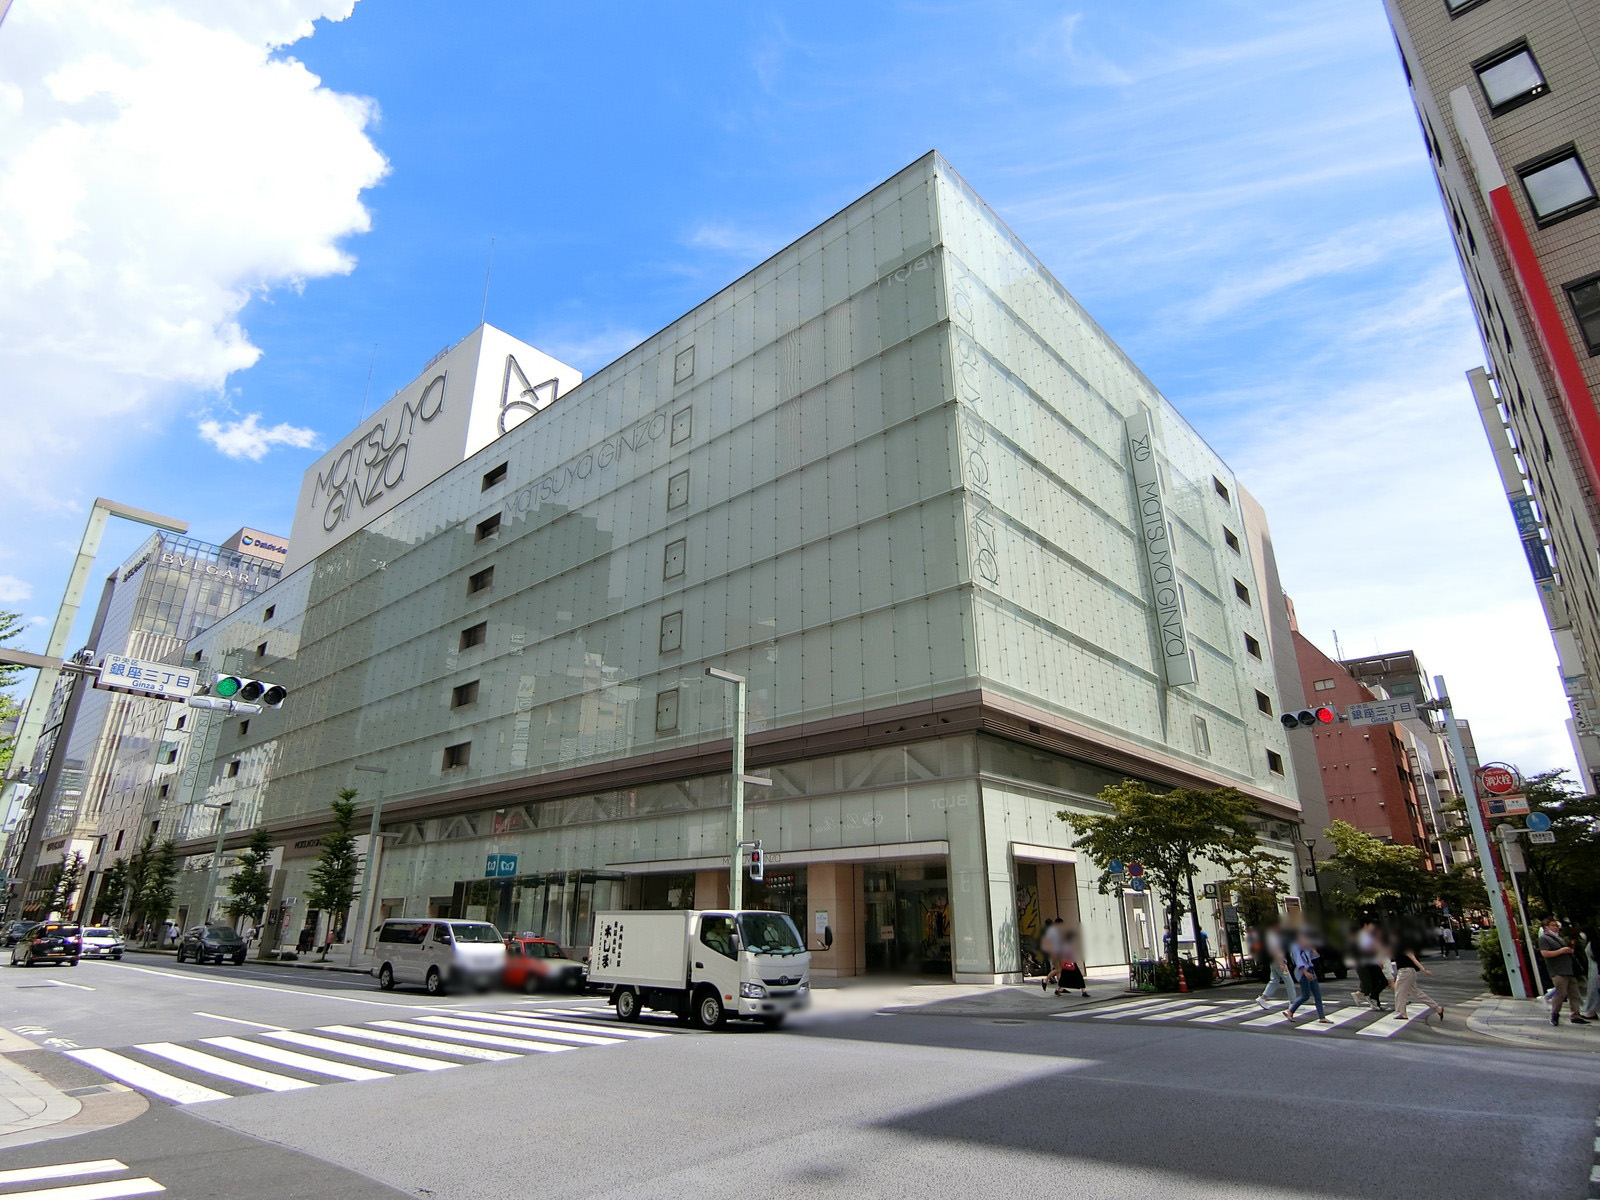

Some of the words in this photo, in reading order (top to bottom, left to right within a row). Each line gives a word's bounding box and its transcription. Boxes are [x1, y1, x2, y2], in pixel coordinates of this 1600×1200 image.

[113, 656, 139, 666] 中央区
[109, 662, 191, 688] 銀座三丁目
[132, 680, 155, 690] Ginza
[1351, 702, 1412, 720] 銀座三丁目
[1484, 774, 1512, 787] 消火栓
